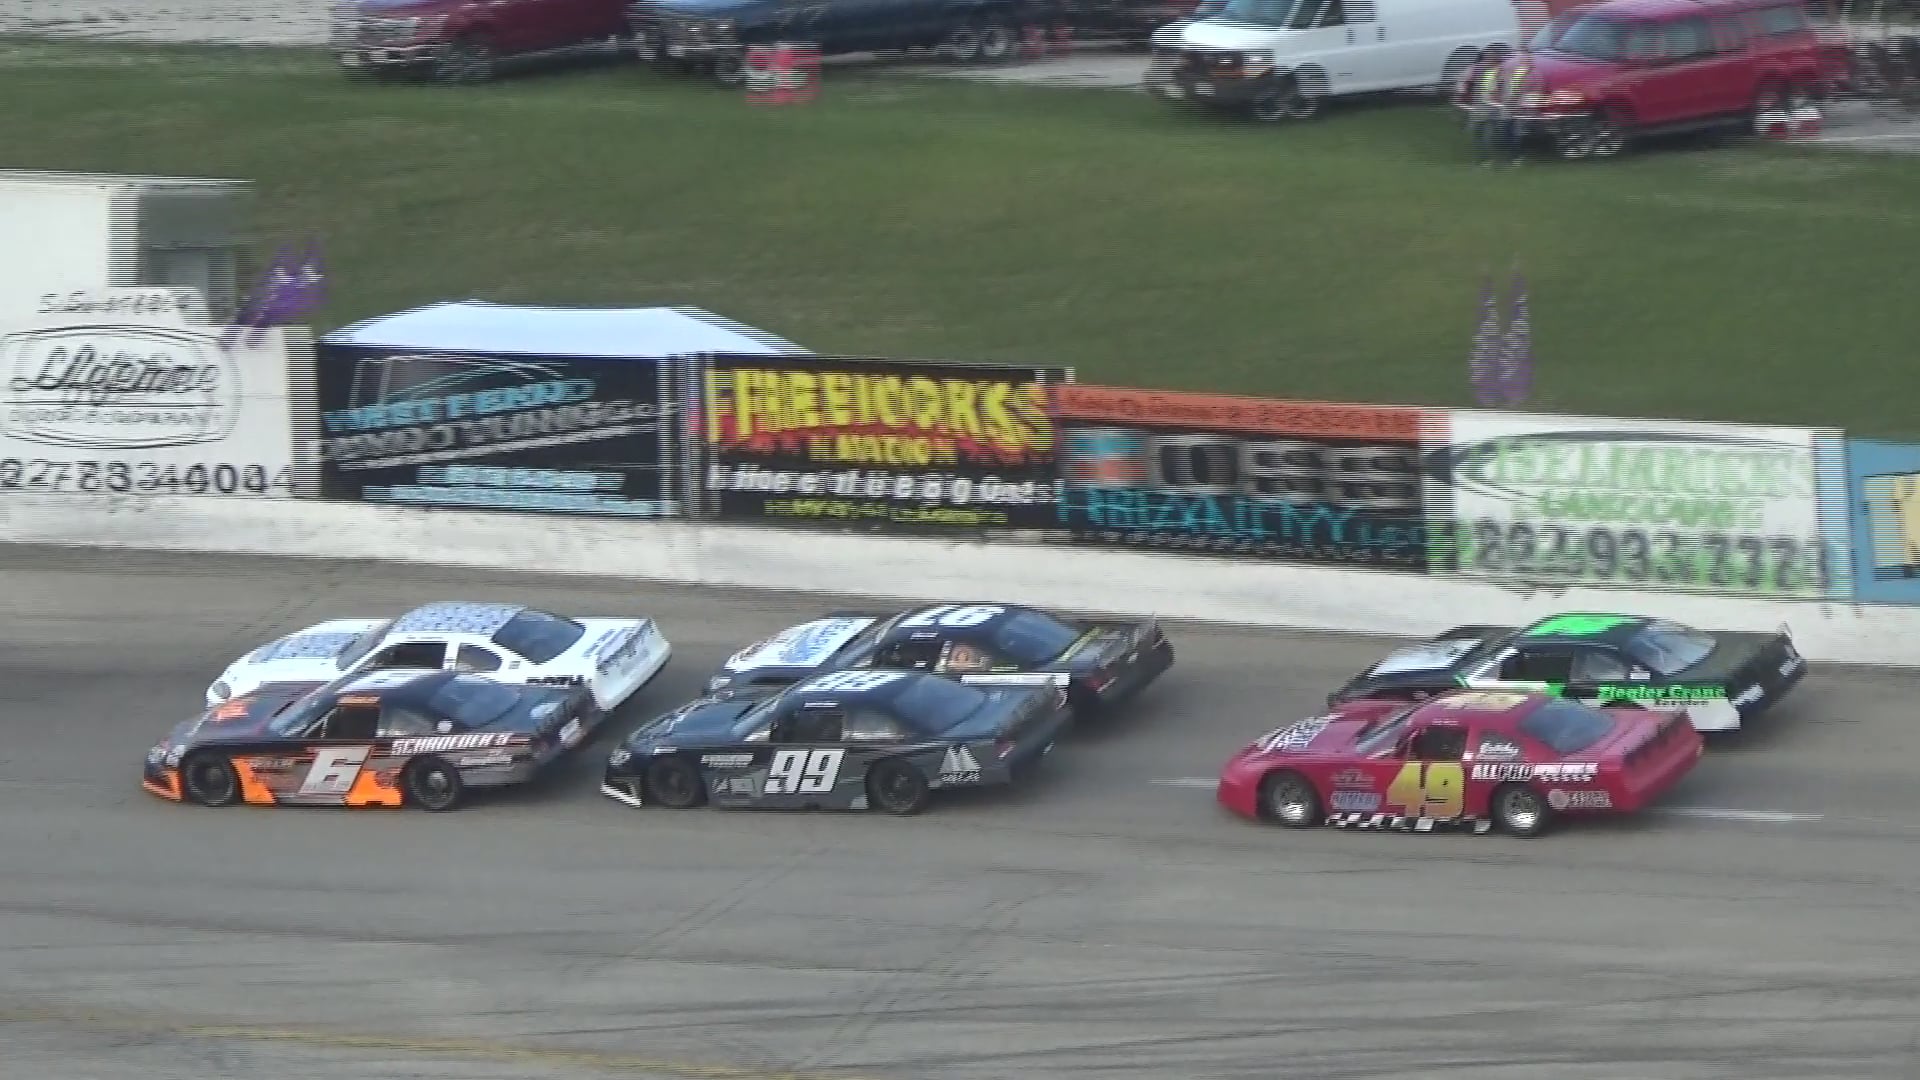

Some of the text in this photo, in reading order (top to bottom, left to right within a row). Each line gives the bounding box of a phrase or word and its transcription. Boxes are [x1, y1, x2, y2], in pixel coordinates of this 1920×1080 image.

[705, 368, 1054, 452] FIREWORKS
[300, 744, 374, 795] 6
[764, 748, 846, 794] 99
[1386, 760, 1465, 819] 49
